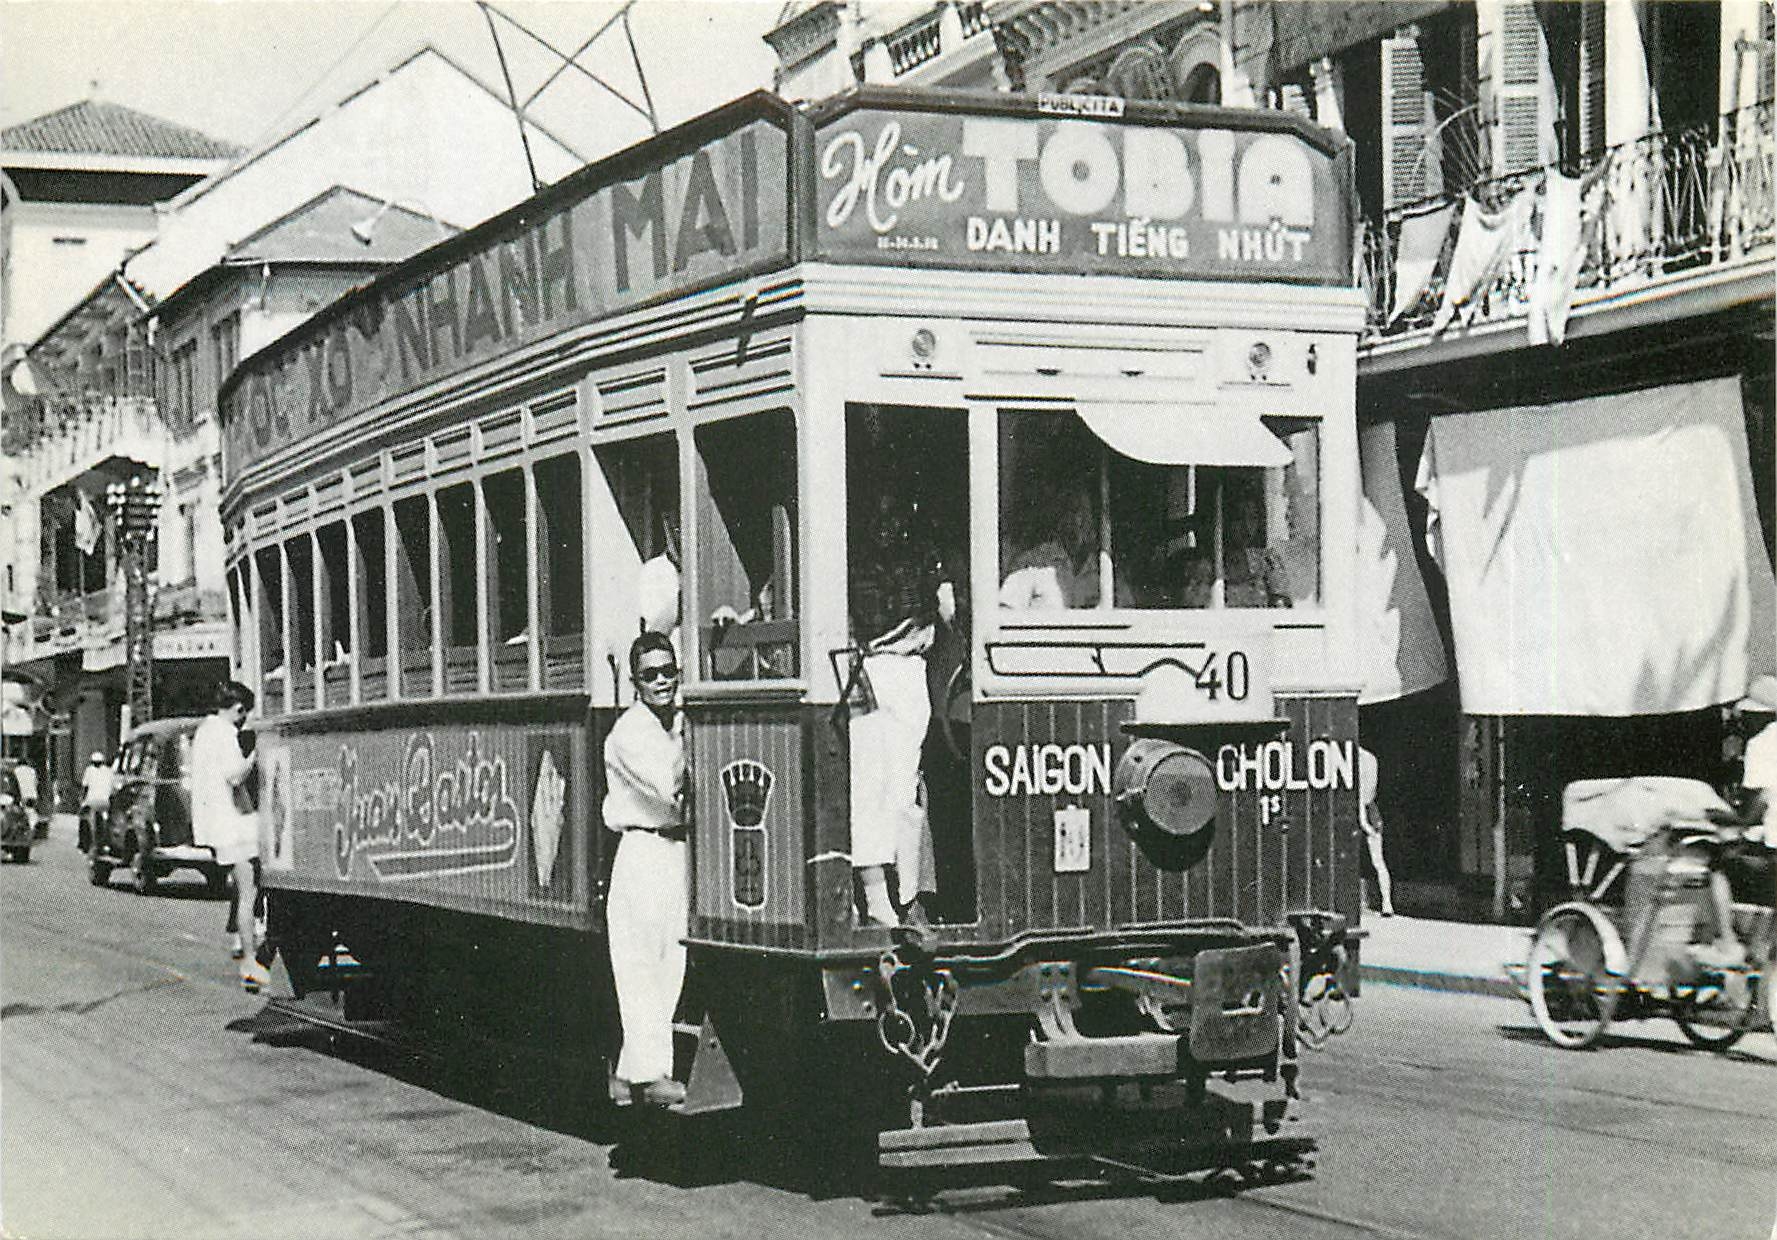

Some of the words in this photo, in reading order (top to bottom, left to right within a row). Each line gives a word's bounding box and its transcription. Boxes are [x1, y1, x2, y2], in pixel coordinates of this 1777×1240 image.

[961, 117, 1315, 227] TOBIA
[610, 128, 761, 296] MAI
[966, 216, 1061, 253] DANH
[1091, 214, 1189, 258] TIẾNG
[1195, 650, 1249, 701] 40
[985, 744, 1112, 796] SAIGON
[1216, 740, 1354, 791] CHOLON
